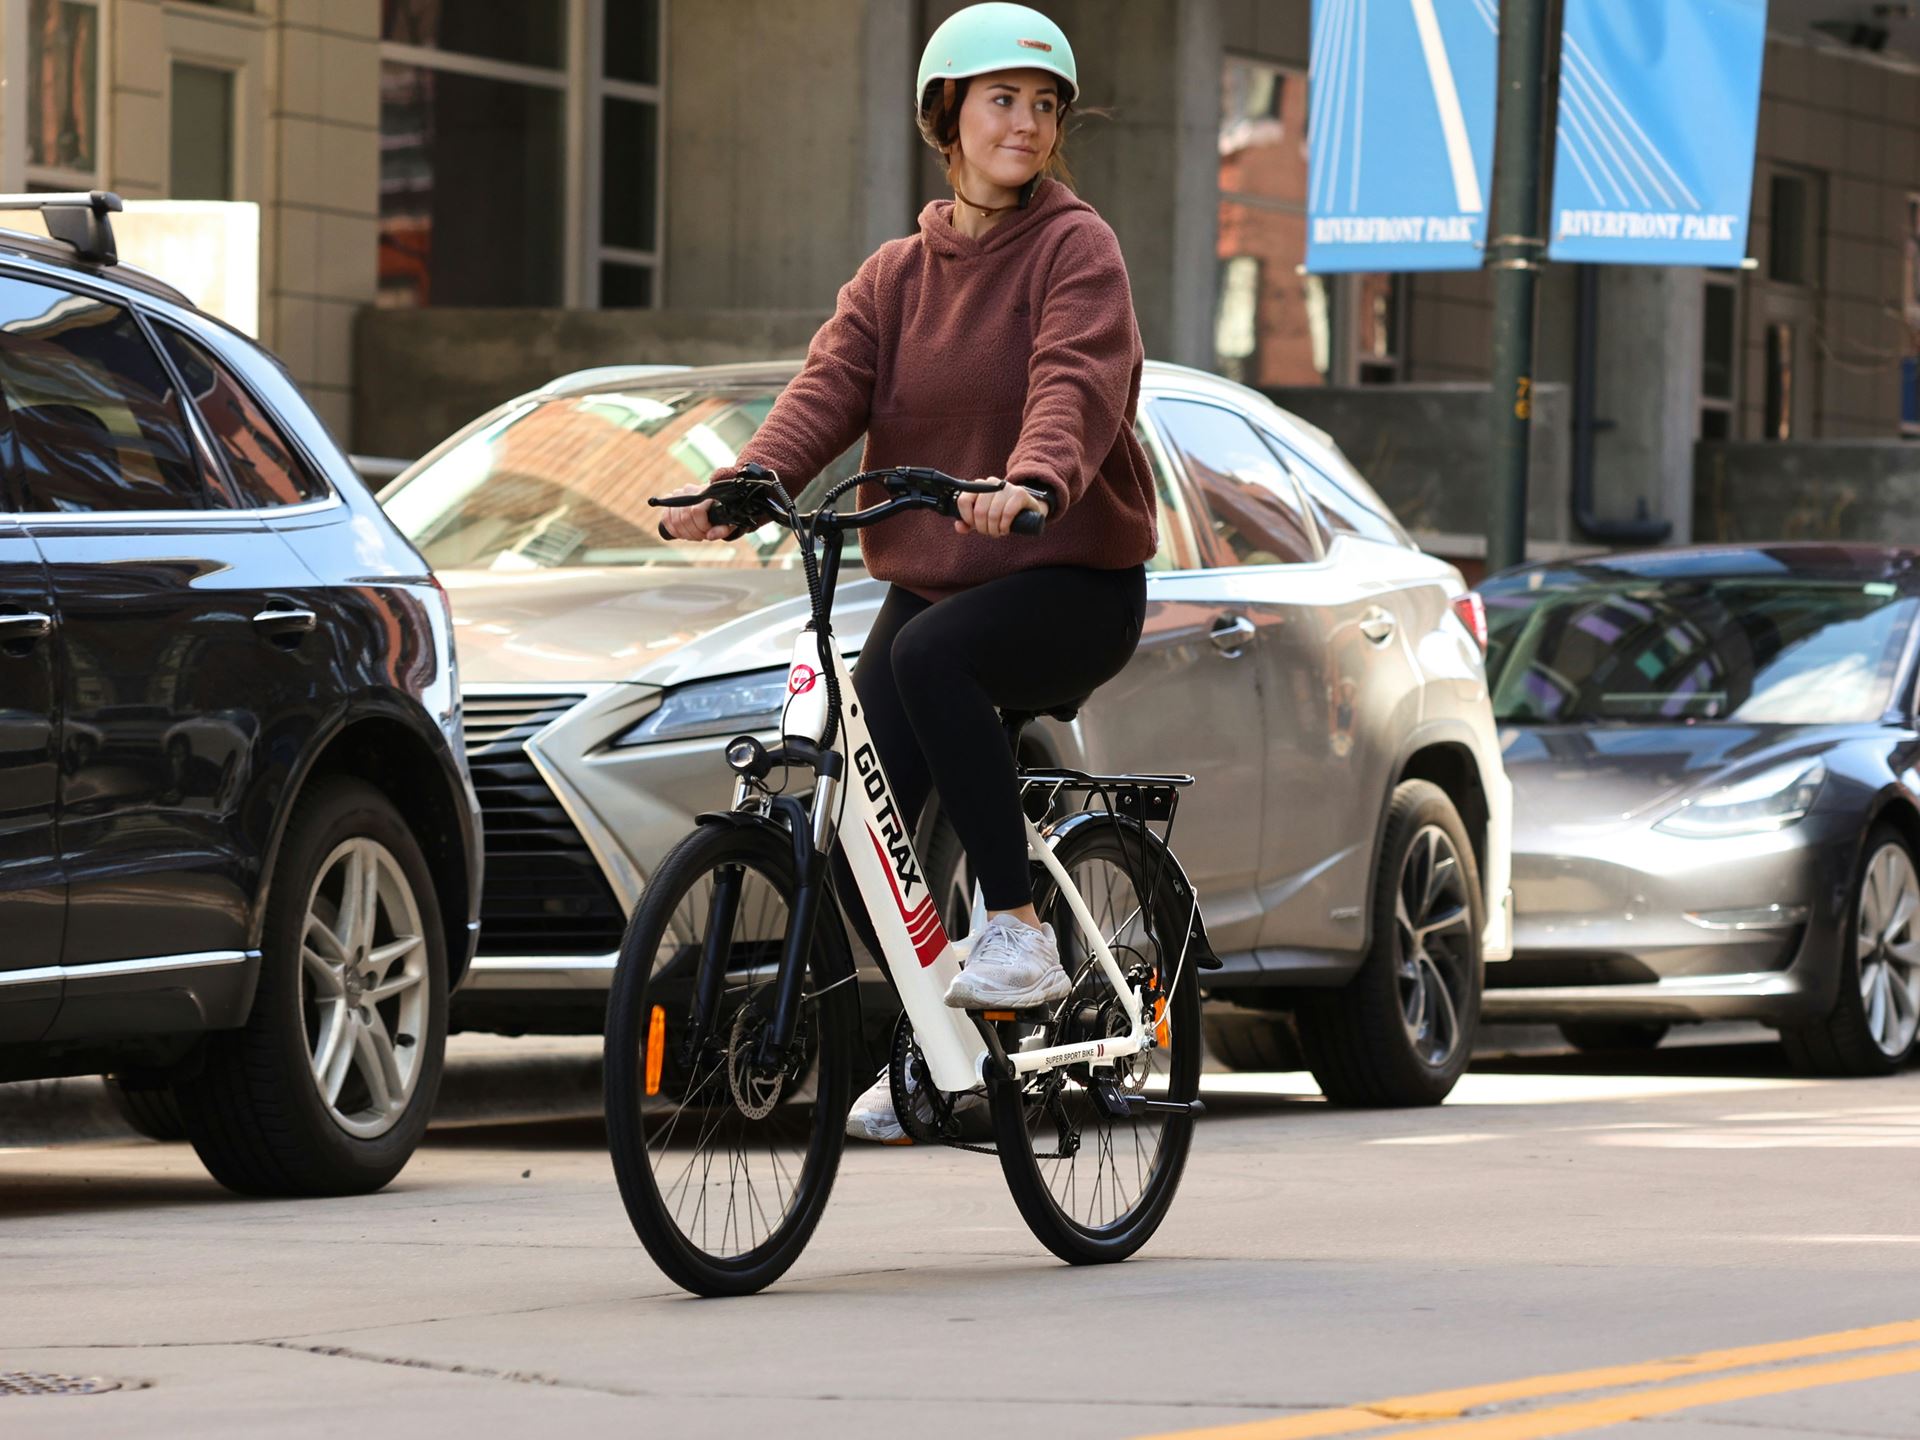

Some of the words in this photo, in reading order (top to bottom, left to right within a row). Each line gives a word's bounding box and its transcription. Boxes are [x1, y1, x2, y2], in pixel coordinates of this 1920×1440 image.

[1313, 216, 1425, 244] RIVERFRONT
[1425, 216, 1473, 243] PARK
[1560, 209, 1682, 239] RIVERFRONT
[1682, 214, 1732, 241] PARK
[854, 742, 922, 898] GOTRAX
[1046, 1055, 1063, 1065] SUPER
[1064, 1051, 1081, 1061] SPORT
[1082, 1049, 1094, 1058] BIKE
